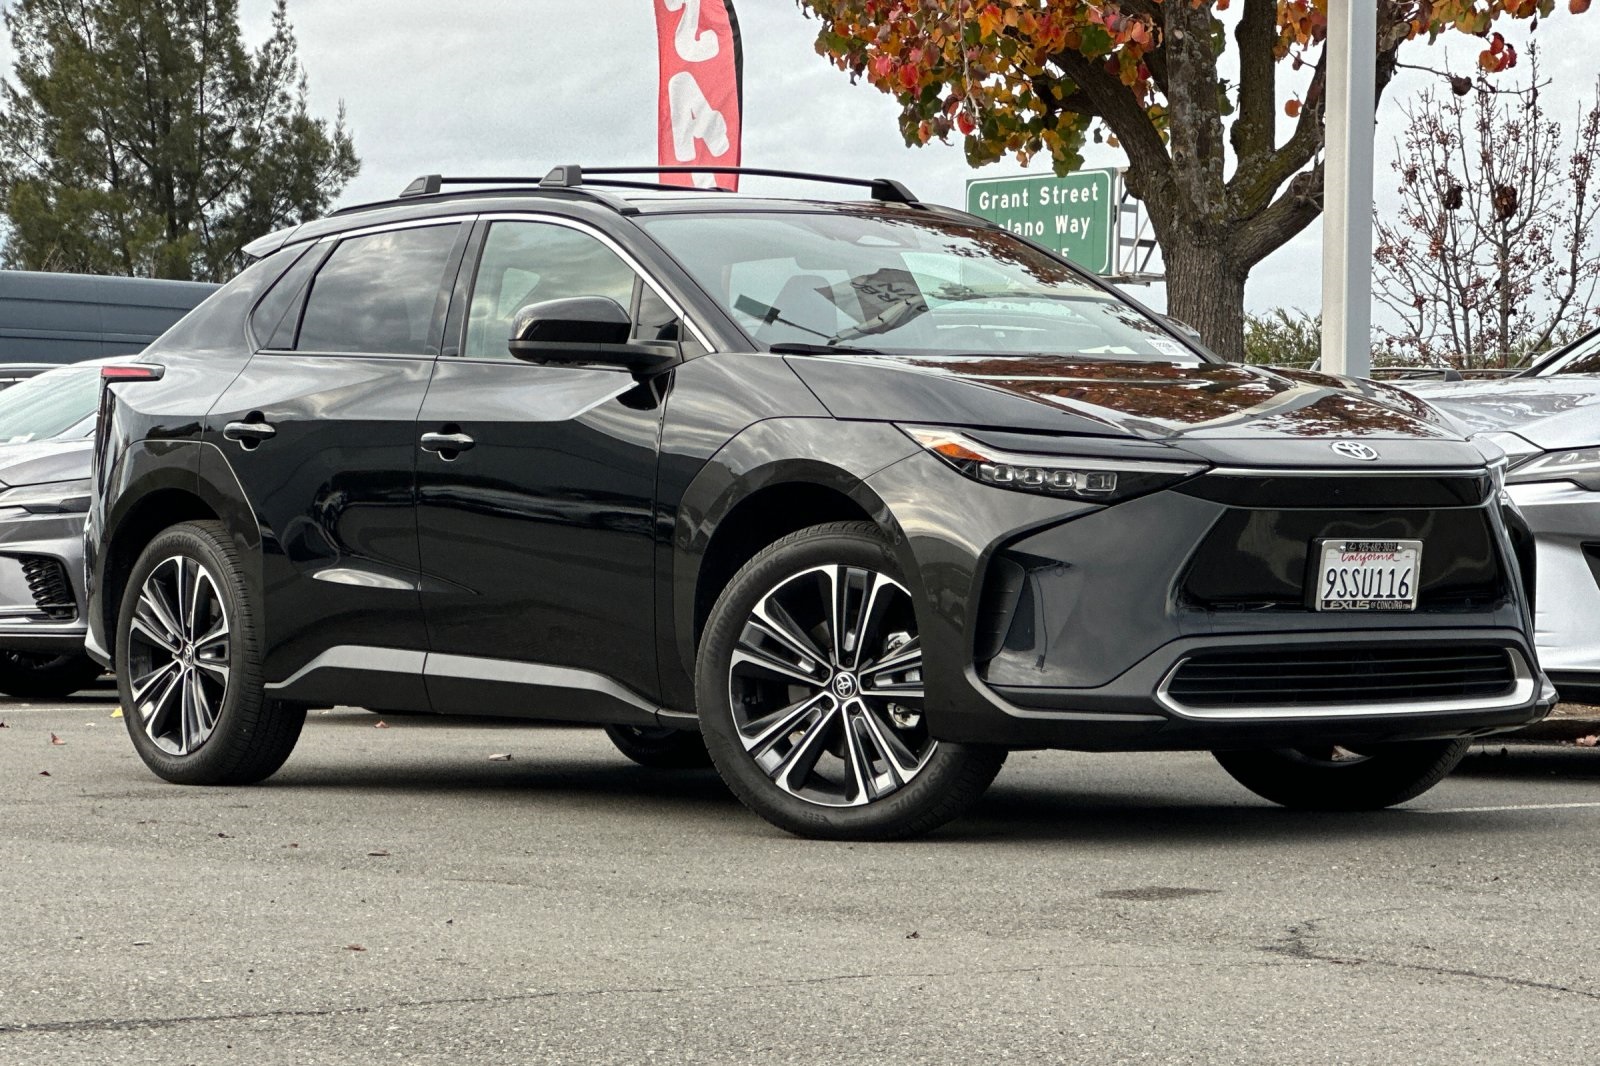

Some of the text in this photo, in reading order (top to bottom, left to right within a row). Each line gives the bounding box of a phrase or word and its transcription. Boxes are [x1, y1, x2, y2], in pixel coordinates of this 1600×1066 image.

[979, 182, 1099, 211] Grant Street
[1055, 214, 1091, 240] Way
[1341, 552, 1400, 567] California
[1323, 568, 1412, 599] 9SSU116
[1322, 600, 1370, 610] LEXUS
